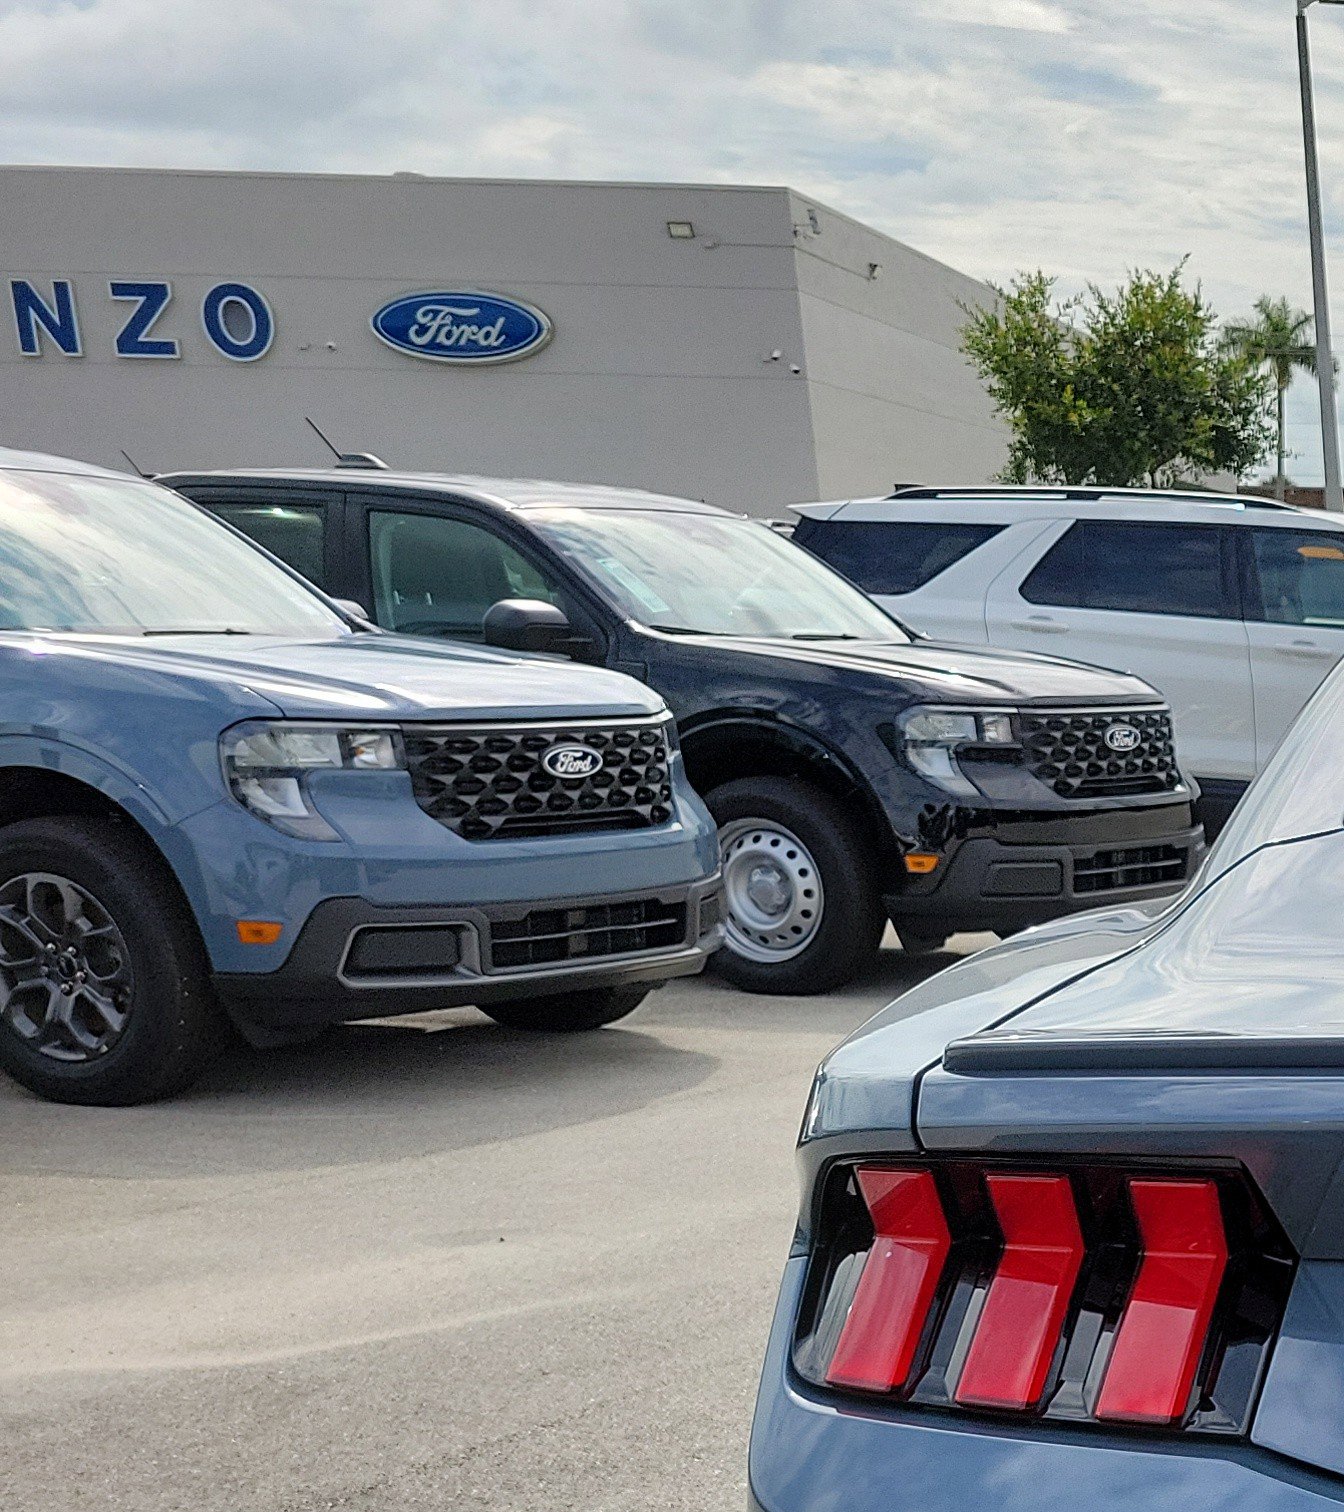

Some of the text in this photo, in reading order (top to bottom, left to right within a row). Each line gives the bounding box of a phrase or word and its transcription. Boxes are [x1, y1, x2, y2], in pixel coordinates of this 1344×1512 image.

[10, 279, 275, 362] NZO
[408, 304, 506, 346] Ford
[555, 751, 593, 773] Ford
